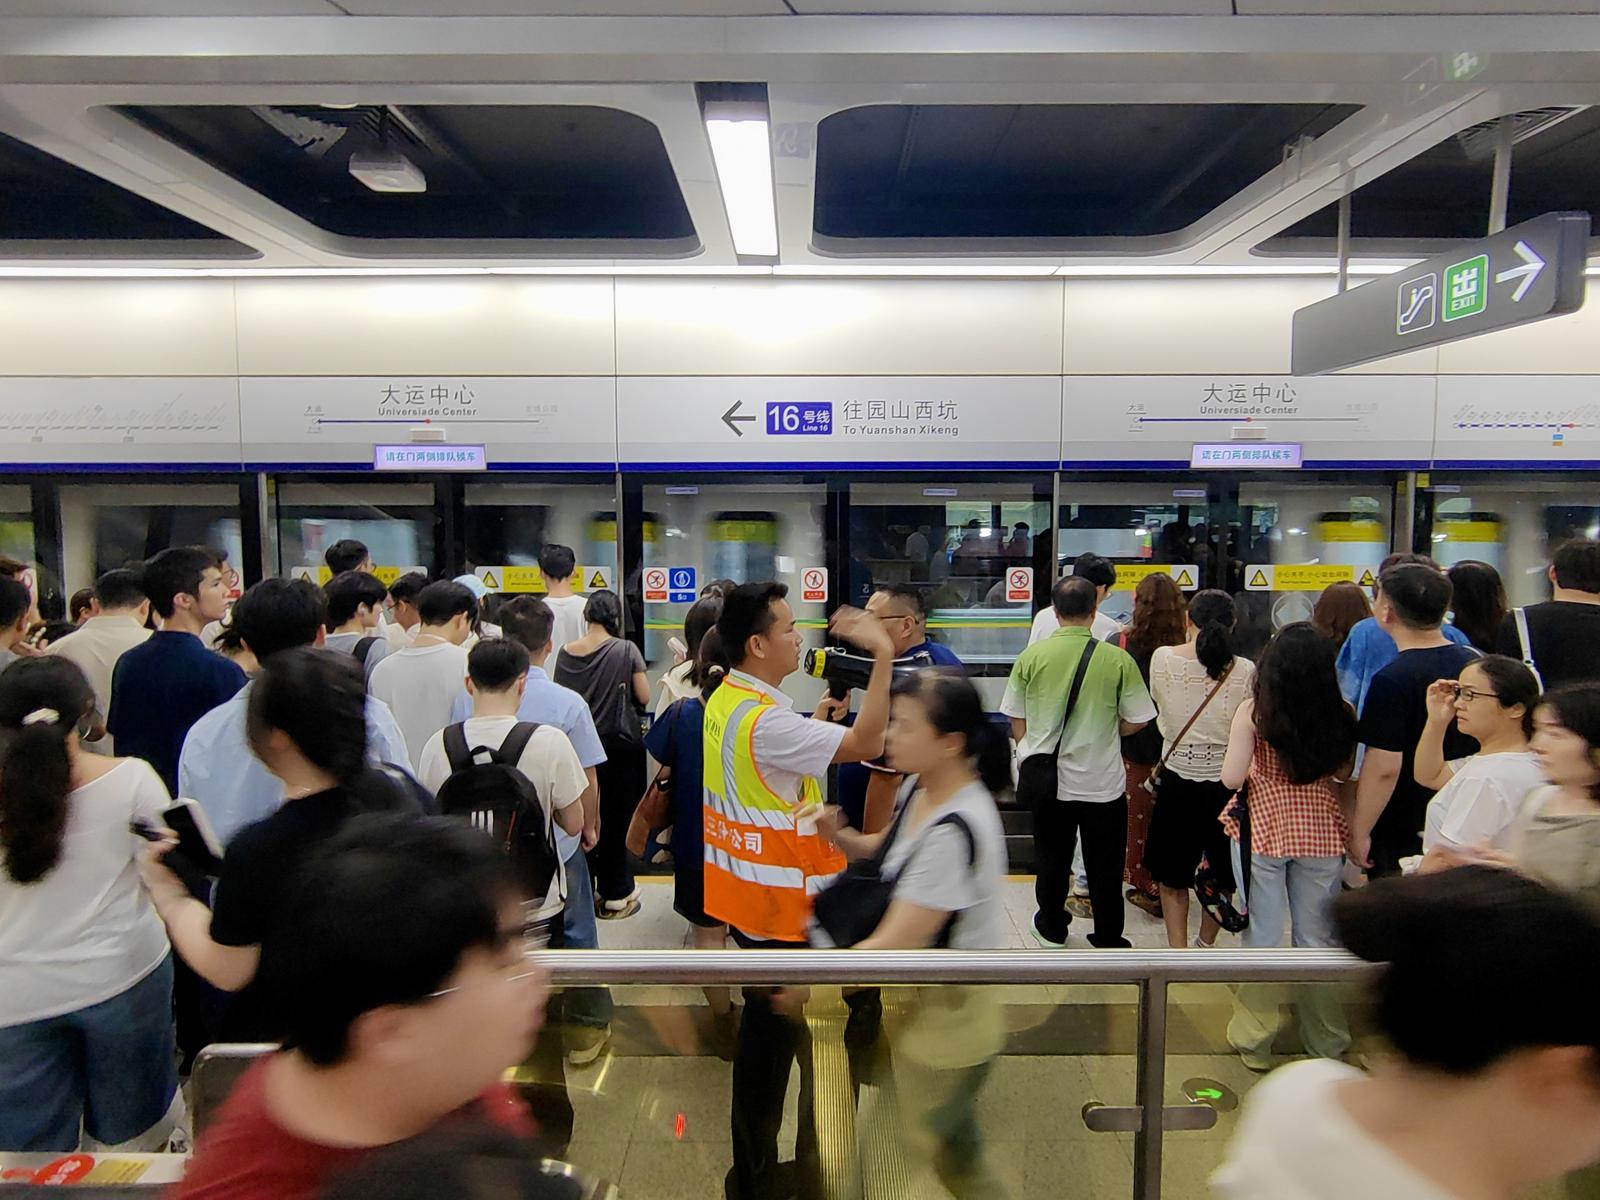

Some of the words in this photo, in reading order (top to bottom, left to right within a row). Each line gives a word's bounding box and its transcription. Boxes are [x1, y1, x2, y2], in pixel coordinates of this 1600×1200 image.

[1453, 268, 1478, 298] 出
[1452, 295, 1477, 311] EXIT
[380, 384, 475, 405] 大运中心
[1203, 383, 1297, 404] 大运中心
[378, 408, 439, 416] Universiade
[442, 408, 477, 416] Center
[768, 405, 799, 430] 16
[803, 411, 830, 424] 号线
[843, 400, 958, 420] 往园山西坑
[1200, 406, 1261, 414] Universiade
[1264, 406, 1298, 414] Center
[843, 426, 856, 434] To
[860, 426, 915, 435] Yuanshan
[919, 426, 959, 436] Xikeng
